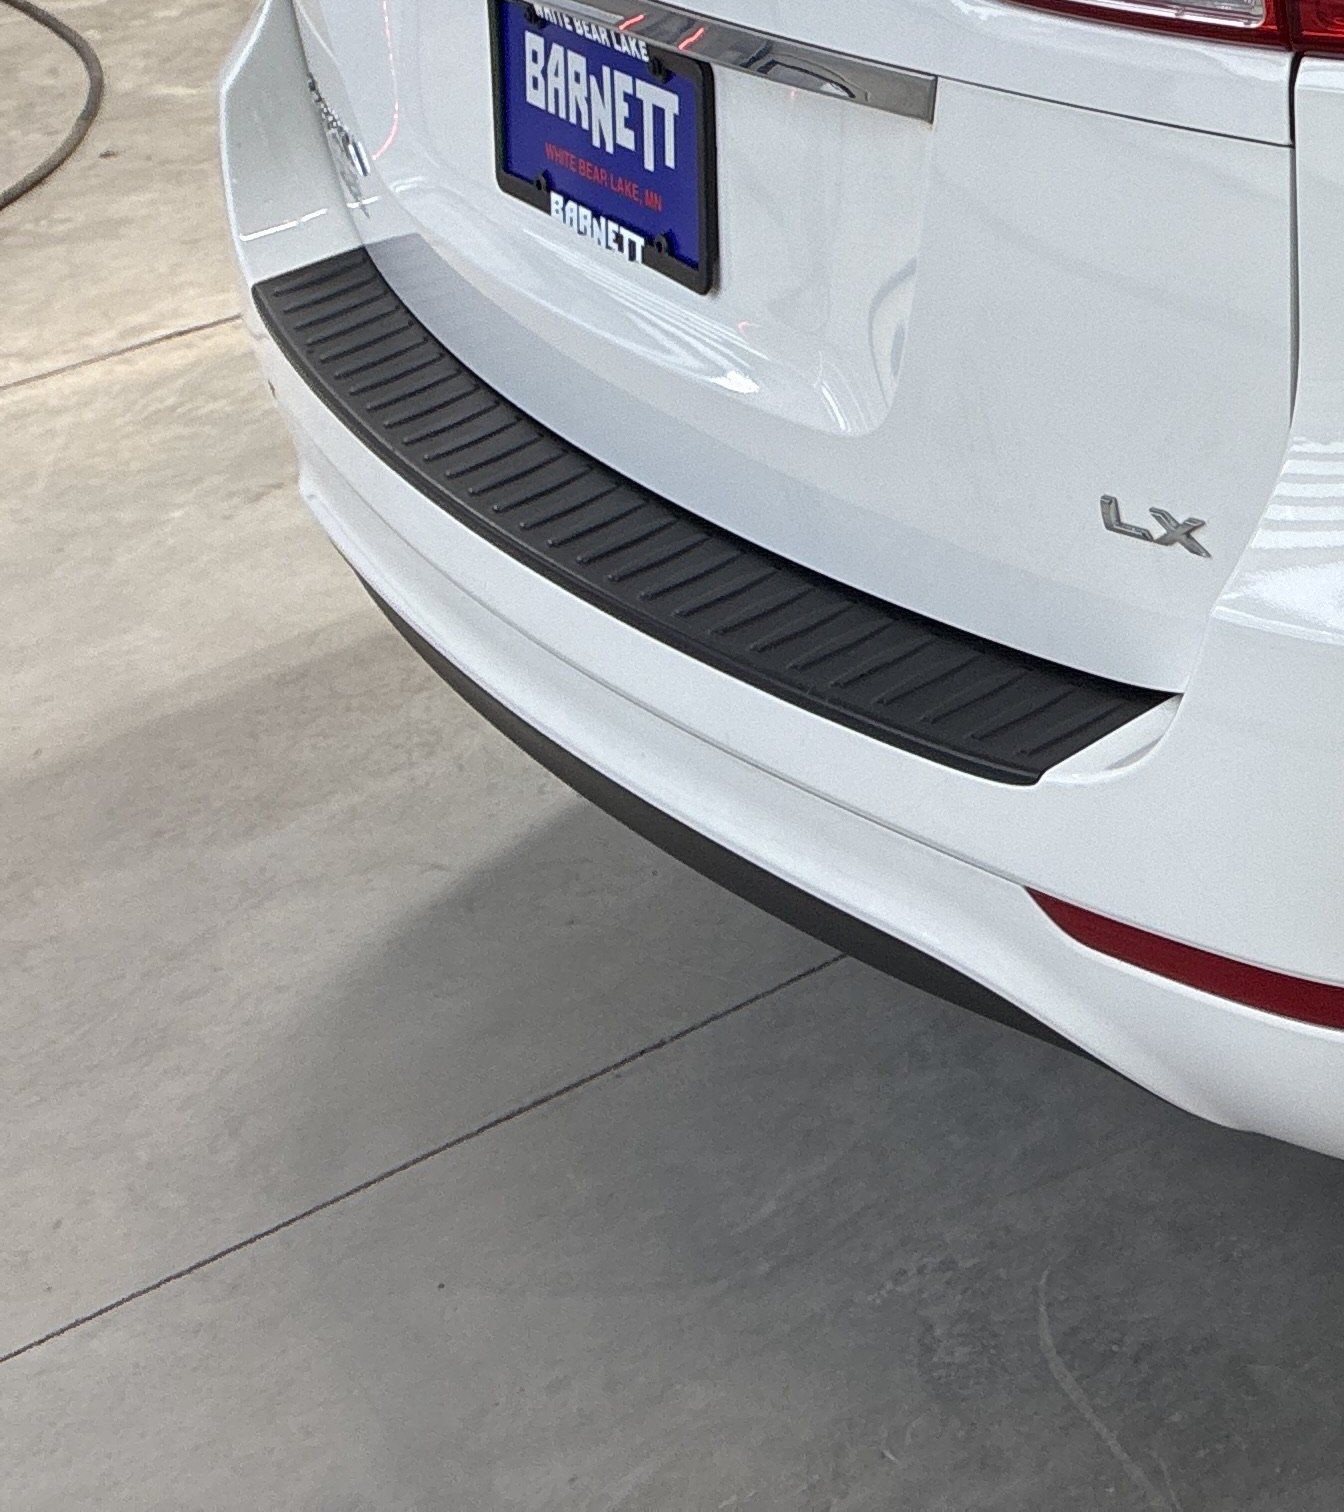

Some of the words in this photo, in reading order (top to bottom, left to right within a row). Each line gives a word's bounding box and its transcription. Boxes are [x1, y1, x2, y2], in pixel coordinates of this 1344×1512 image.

[534, 2, 574, 32] WHITE
[574, 18, 611, 48] BEAR
[611, 31, 650, 63] LAKE
[525, 30, 679, 173] BARNETT
[545, 141, 577, 174] WHITE
[578, 157, 609, 187] BEAR
[609, 172, 642, 206] LAKE,
[644, 189, 663, 213] MN
[551, 190, 645, 265] BARNETT
[1100, 493, 1212, 558] LX
